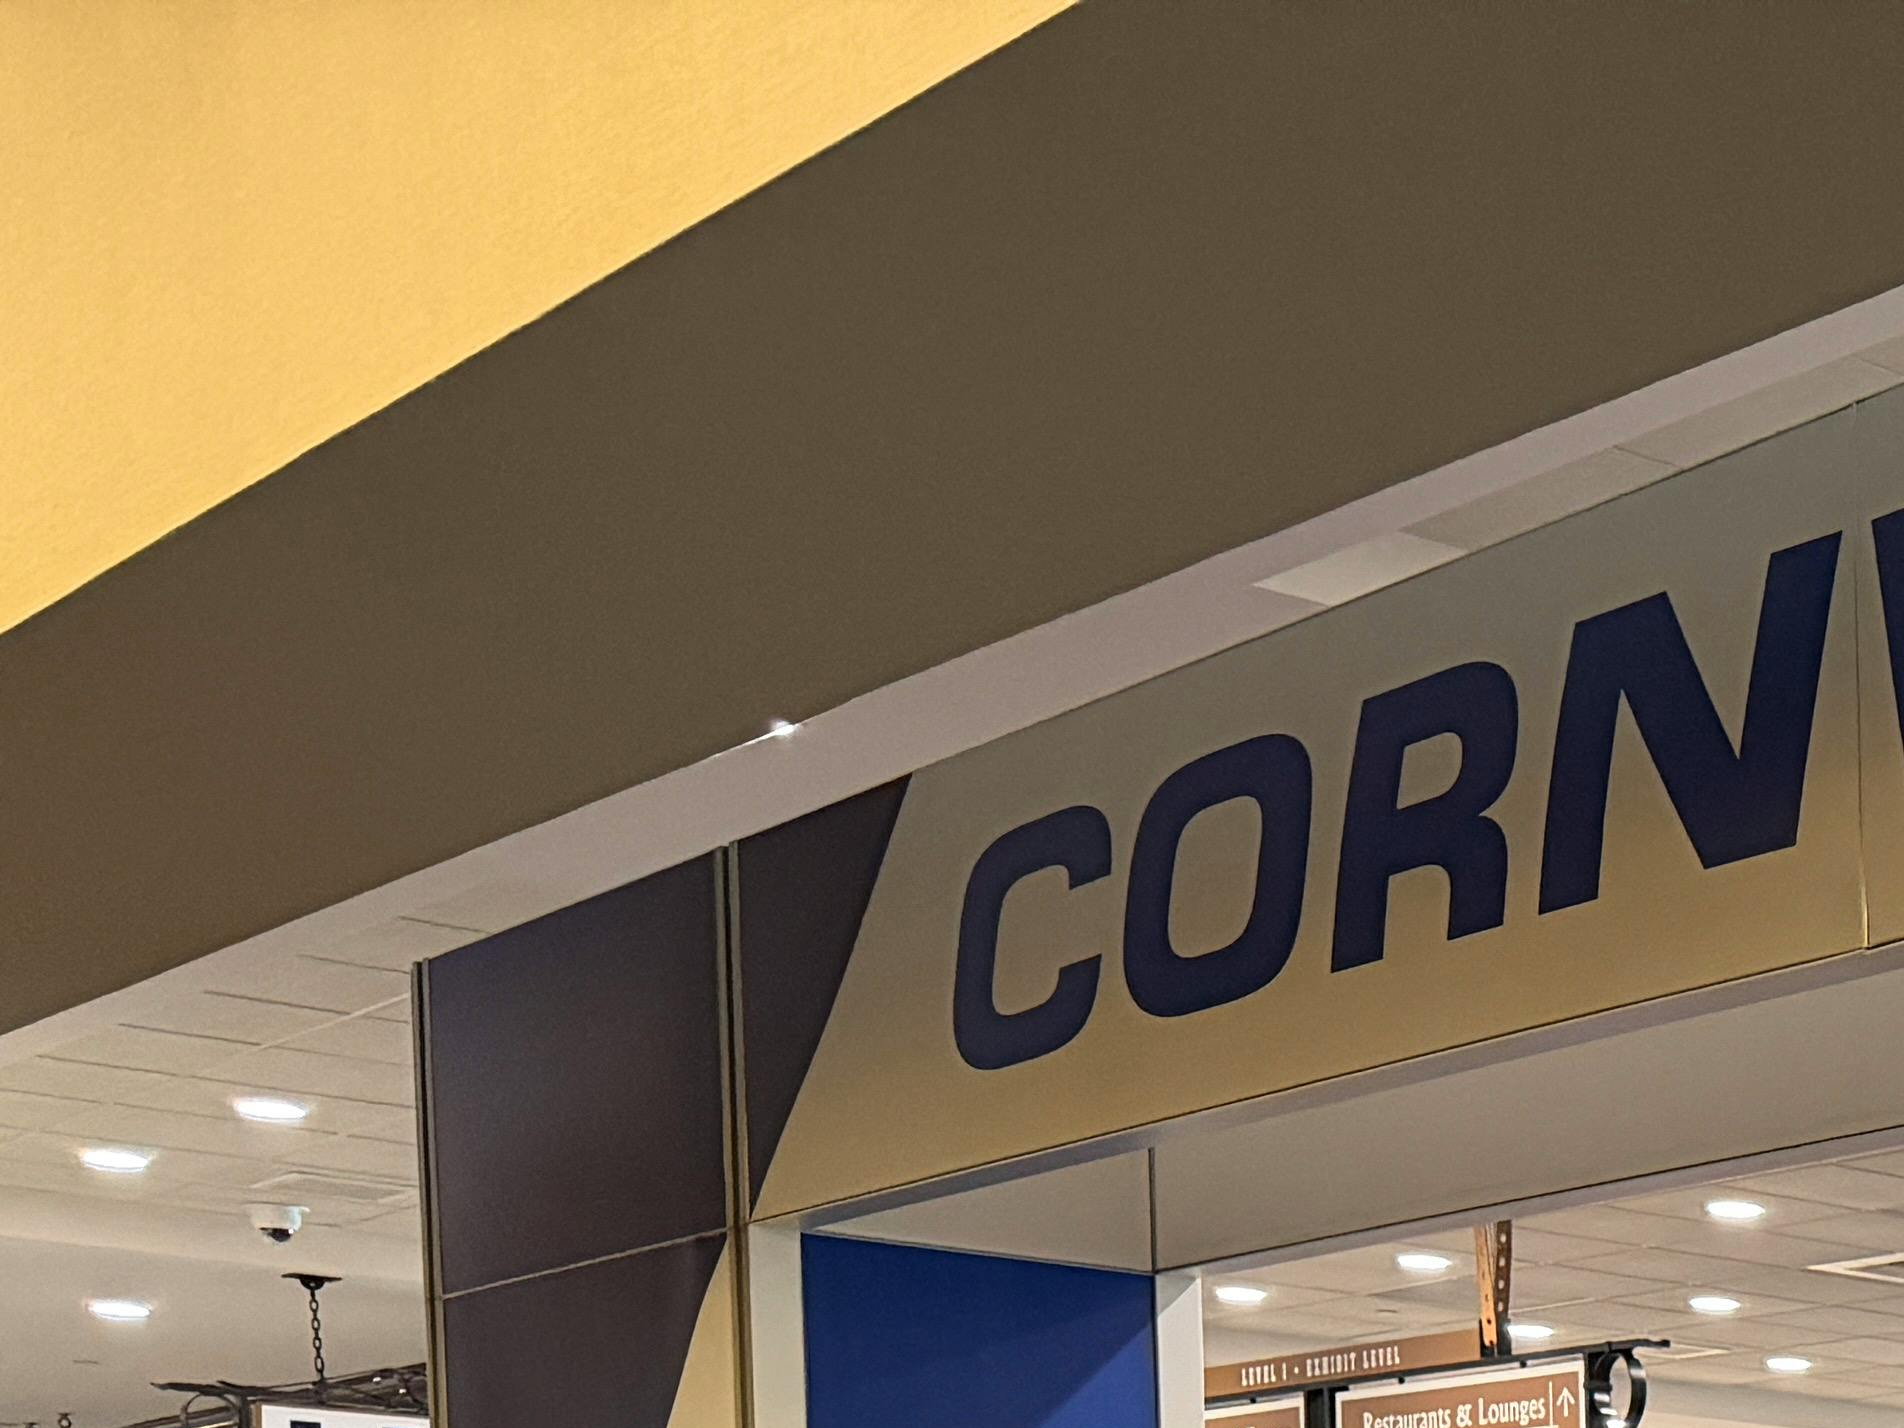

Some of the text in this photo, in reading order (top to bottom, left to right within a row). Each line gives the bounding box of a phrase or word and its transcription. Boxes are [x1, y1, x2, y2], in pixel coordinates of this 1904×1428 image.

[1241, 1364, 1276, 1387] LEVEL
[1306, 1352, 1357, 1378] EXHIBIT
[1362, 1345, 1400, 1369] LEVEL
[1456, 1403, 1473, 1428] &
[1478, 1397, 1546, 1426] Lounges
